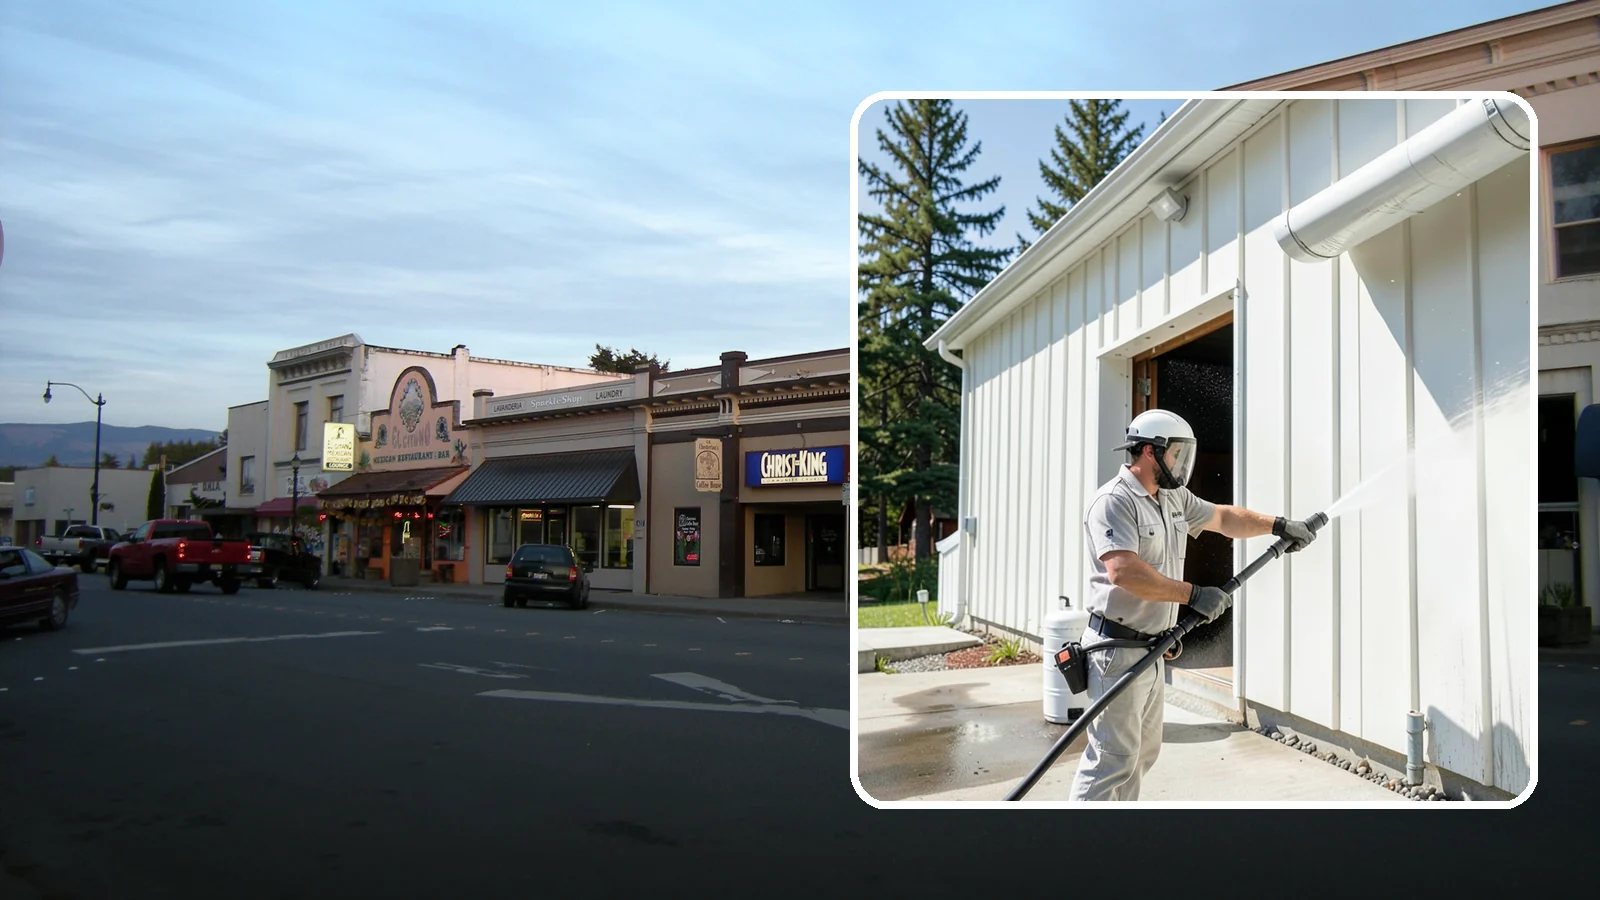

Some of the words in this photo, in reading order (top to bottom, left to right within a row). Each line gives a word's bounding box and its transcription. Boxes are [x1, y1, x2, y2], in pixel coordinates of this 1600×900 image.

[531, 395, 560, 408] Sparkle
[561, 394, 583, 405] Shop
[595, 389, 623, 400] LAUNDRY
[493, 402, 522, 413] LAVANDERIA
[373, 454, 396, 464] MEXICAN
[397, 451, 433, 462] RESTAURANT
[438, 449, 450, 459] BAR
[761, 452, 798, 478] CHRIST
[799, 450, 827, 476] KING
